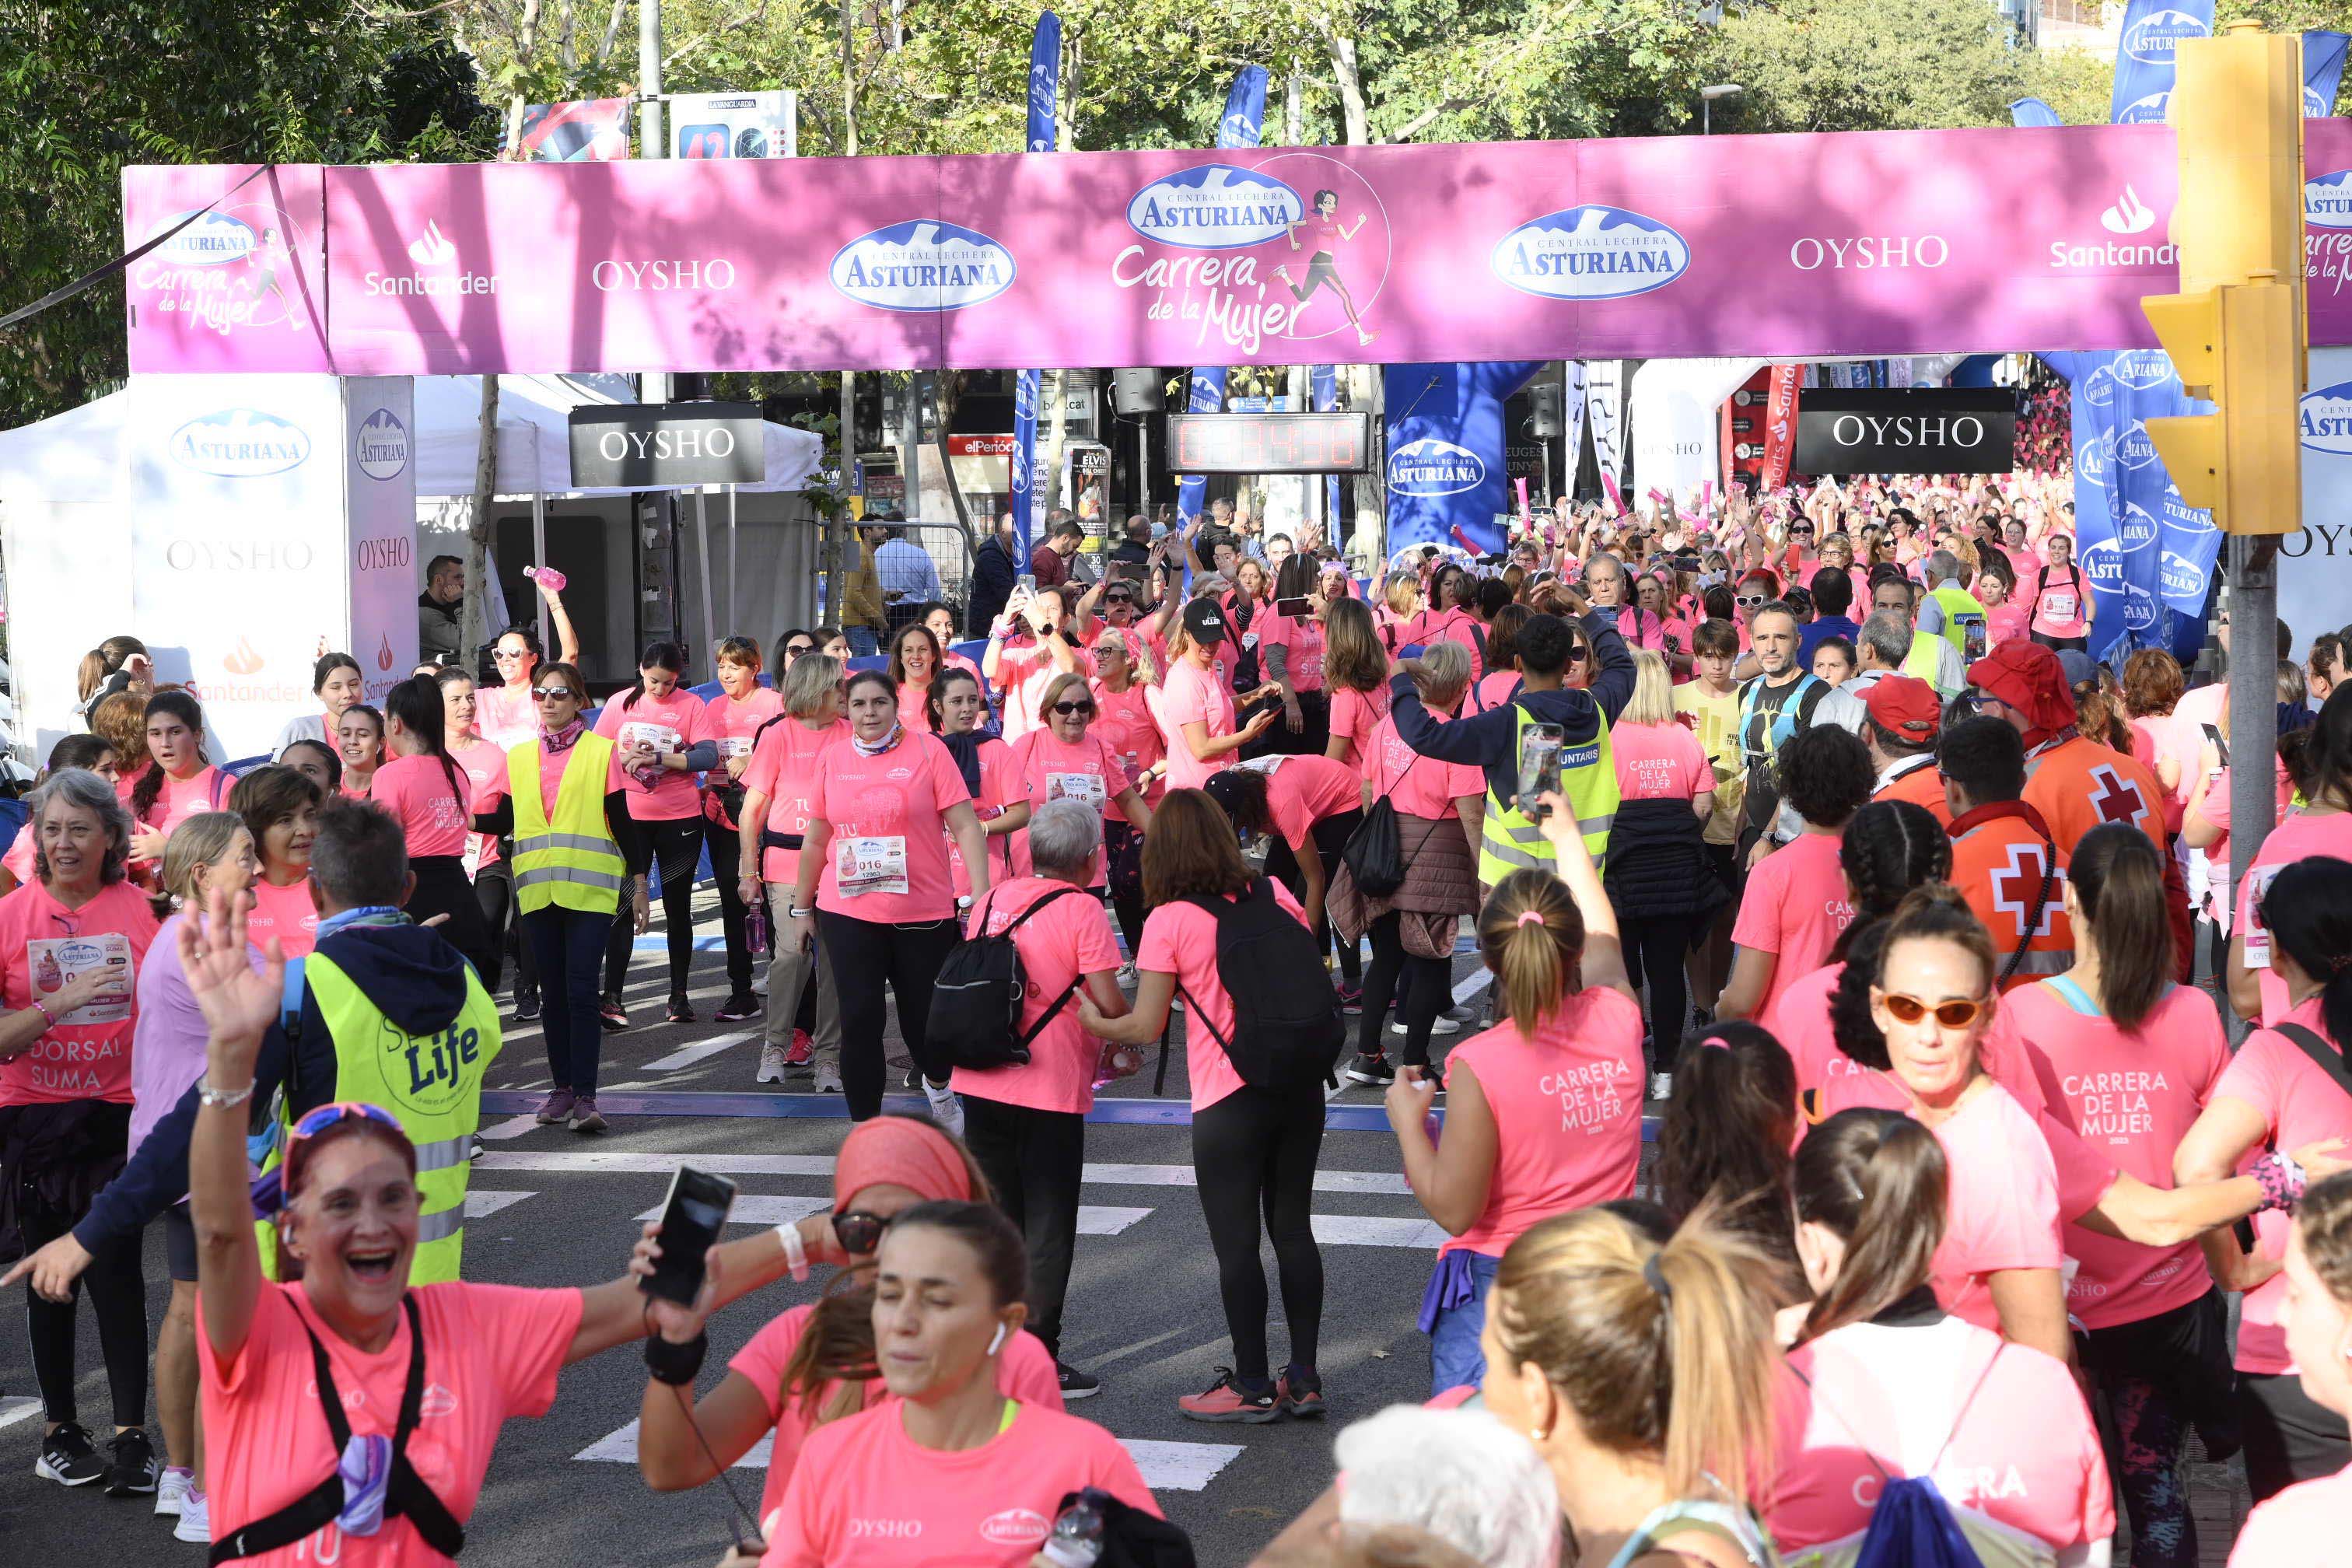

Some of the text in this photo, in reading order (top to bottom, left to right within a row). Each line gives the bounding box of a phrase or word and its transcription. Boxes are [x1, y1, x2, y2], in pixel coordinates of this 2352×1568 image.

[2131, 31, 2201, 51] ASTUR
[1167, 191, 1286, 203] CENTRAL LECHERA
[2305, 193, 2352, 214] ASTU
[1140, 197, 1290, 228] ASTURIANA
[1537, 236, 1668, 248] CENTRAL LECHERA
[1790, 235, 1948, 270] OYSHO
[2050, 240, 2181, 268] Santand
[873, 250, 996, 261] CENTRAL LECHERA
[1112, 244, 1258, 289] Carrera
[1509, 242, 1675, 275] ASTURIANA
[2322, 256, 2336, 278] la
[136, 261, 229, 291] Carrera
[592, 259, 736, 292] OYSHO
[843, 254, 1002, 288] ASTURIANA
[365, 271, 499, 296] Santander
[158, 289, 262, 336] de la Mujer
[1147, 282, 1313, 355] de la Mujer
[1776, 364, 1795, 418] Santa
[1189, 394, 1220, 413] TURIANA
[2321, 405, 2352, 414] CENT
[1833, 415, 1983, 447] OYSHO
[180, 434, 301, 460] ASTURIANA
[360, 436, 405, 463] ASTURIANA
[600, 428, 735, 460] OYSHO
[965, 439, 1014, 453] elPeriód
[1083, 455, 1108, 465] ELVIS
[1770, 445, 1784, 494] ports
[1390, 463, 1478, 484] ASTURIANA
[2278, 524, 2352, 558] OY
[166, 540, 313, 571] OYSHO
[358, 537, 410, 572] OYSHO
[2087, 555, 2123, 579] ASTU
[1301, 663, 1321, 674] SUM
[1388, 747, 1411, 763] DE LA
[1560, 749, 1598, 765] UNTARIS
[1629, 758, 1677, 772] CARRERA
[1639, 779, 1671, 791] MUJER
[1640, 769, 1668, 780] DE LA
[428, 796, 467, 809] CARREA
[436, 807, 449, 817] DE
[435, 817, 465, 829] MUJER
[838, 823, 857, 838] TU
[859, 859, 882, 870] 016
[248, 918, 273, 927] YSHO
[30, 1038, 122, 1062] DORSAL
[404, 1021, 479, 1096] Life
[31, 1066, 101, 1089] SUMA
[1539, 1057, 1630, 1096] CARRERA
[2063, 1071, 2168, 1096] CARRERA
[1561, 1080, 1618, 1111] DE LA
[2084, 1093, 2149, 1115] DE LA
[1561, 1098, 1622, 1132] MUJER
[2081, 1113, 2154, 1137] MUJER
[2071, 1283, 2107, 1297] SHO
